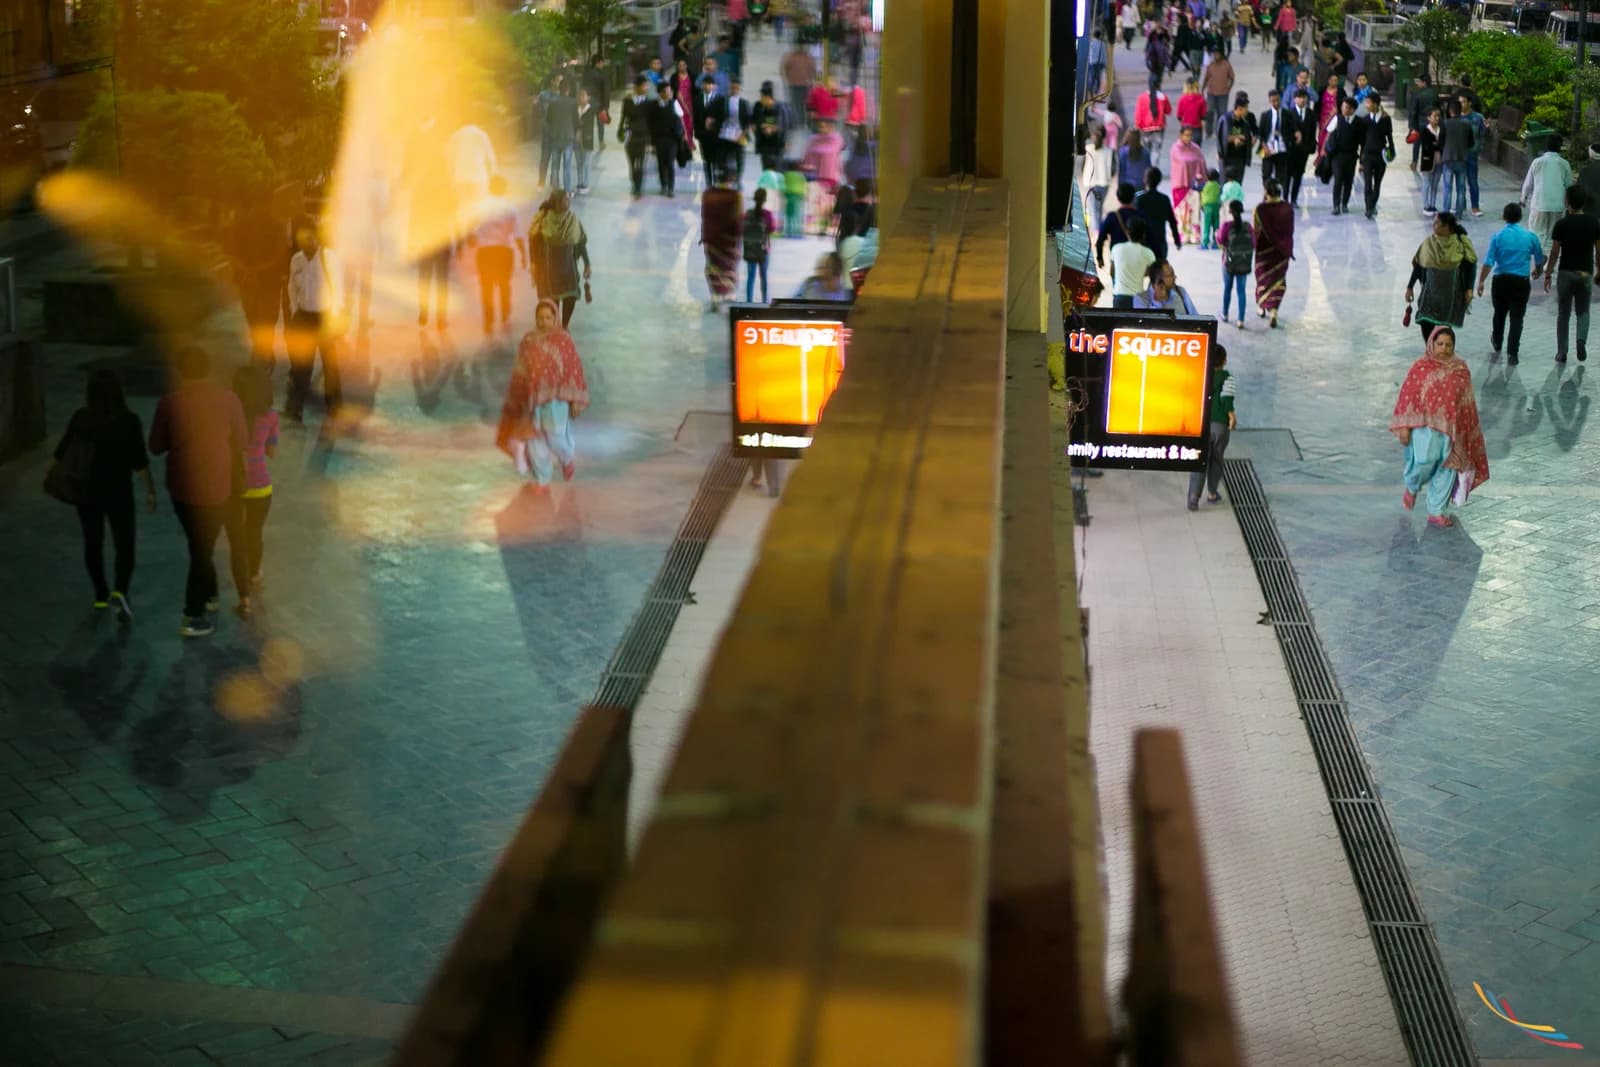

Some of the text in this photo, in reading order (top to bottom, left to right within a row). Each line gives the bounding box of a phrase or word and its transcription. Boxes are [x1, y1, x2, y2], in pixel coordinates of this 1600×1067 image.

[1069, 328, 1201, 361] the square
[1102, 444, 1167, 459] restaurant
[1168, 445, 1179, 459] &
[1180, 446, 1201, 460] bar
